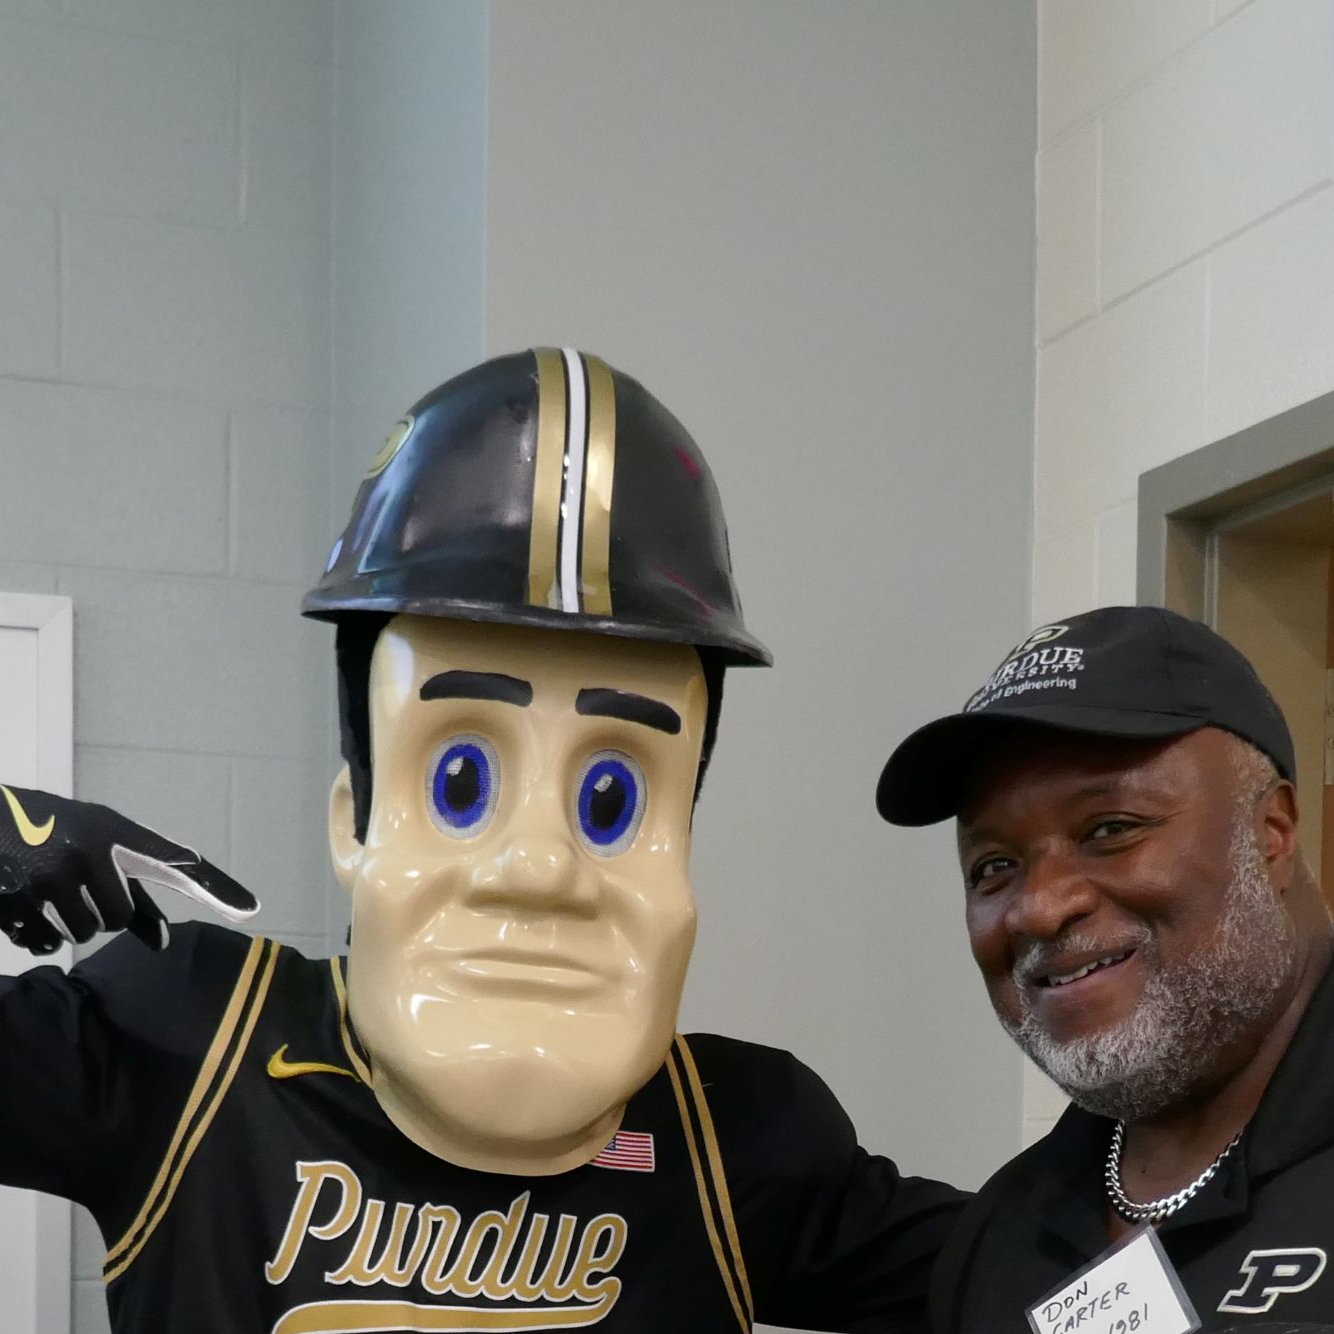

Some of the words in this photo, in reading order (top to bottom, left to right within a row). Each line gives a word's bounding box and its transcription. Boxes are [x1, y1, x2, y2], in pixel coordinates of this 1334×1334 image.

[1004, 676, 1077, 698] Engineering
[265, 1160, 628, 1303] Purdue
[1041, 1280, 1088, 1323] DON
[1217, 1247, 1327, 1314] P
